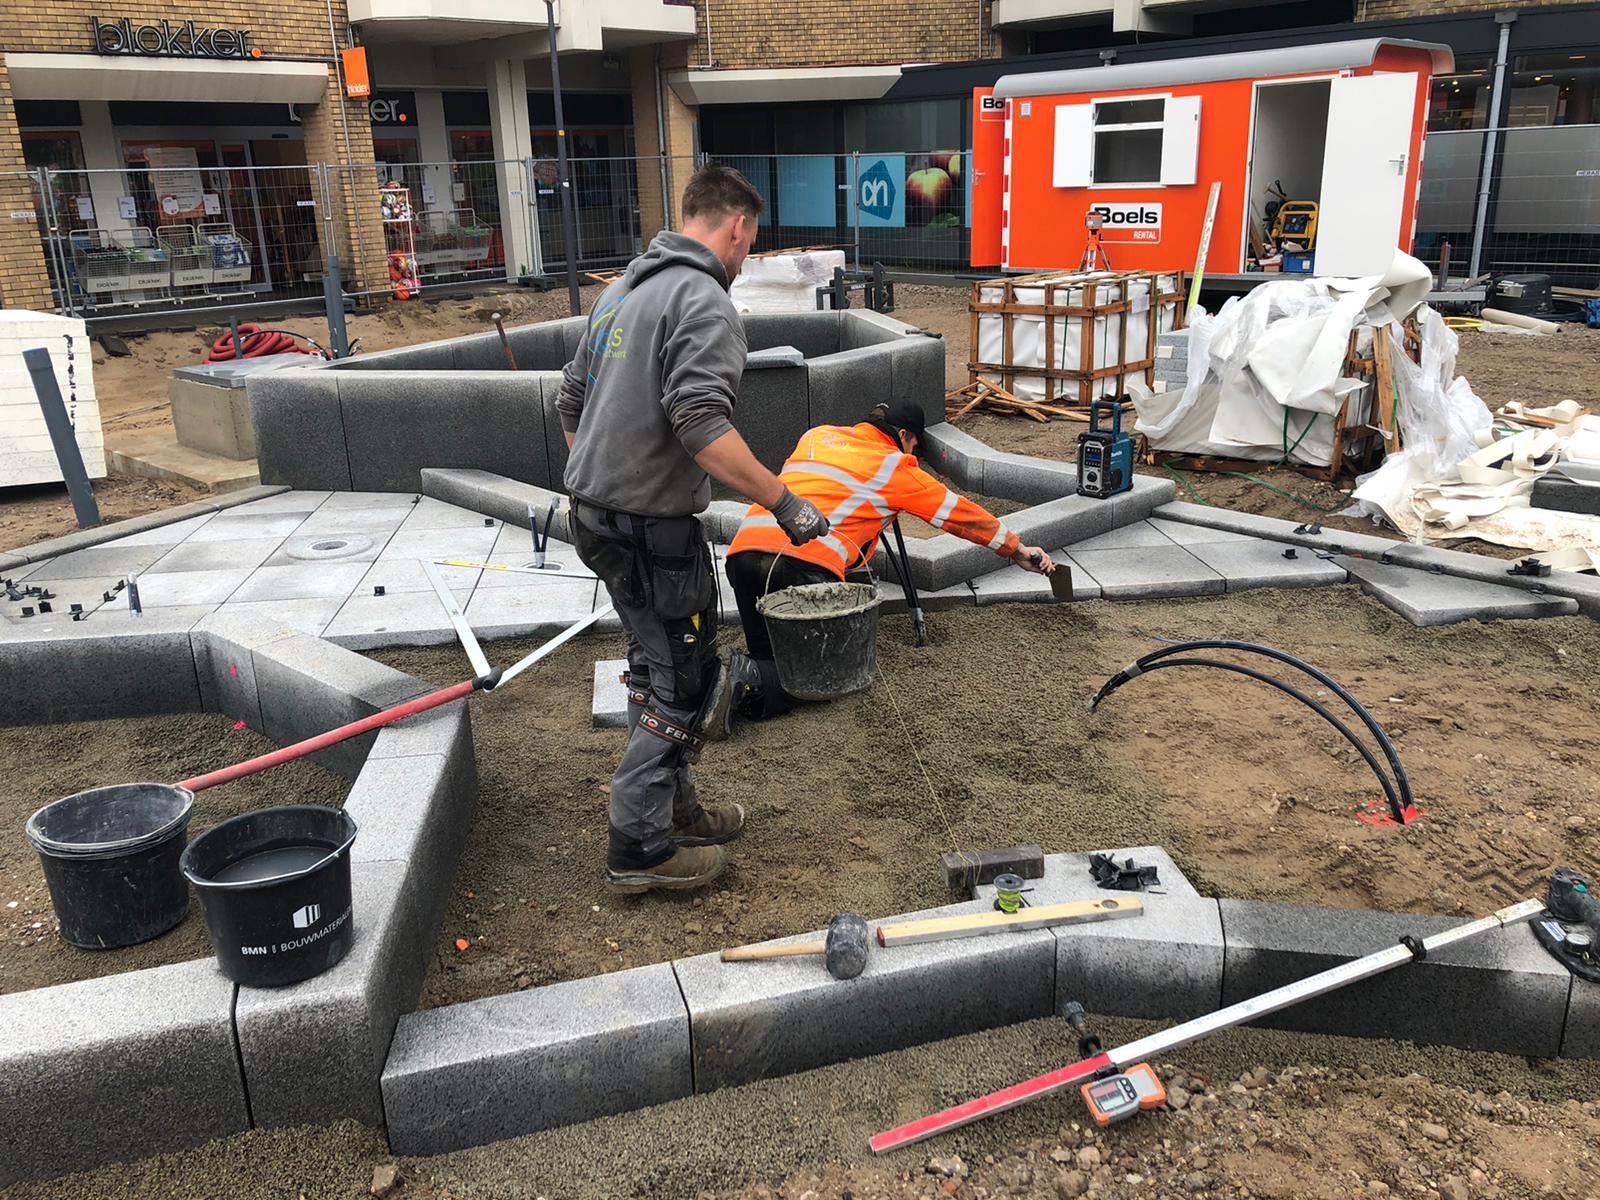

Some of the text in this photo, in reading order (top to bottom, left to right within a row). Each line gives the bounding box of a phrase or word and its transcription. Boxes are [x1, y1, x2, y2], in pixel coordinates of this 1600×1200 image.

[90, 16, 262, 58] blokker.
[369, 98, 407, 122] er.
[983, 98, 1004, 109] Bo
[1094, 207, 1158, 224] Boels
[1133, 231, 1156, 240] RENTAL
[664, 726, 701, 745] FENT
[241, 946, 267, 955] BMN
